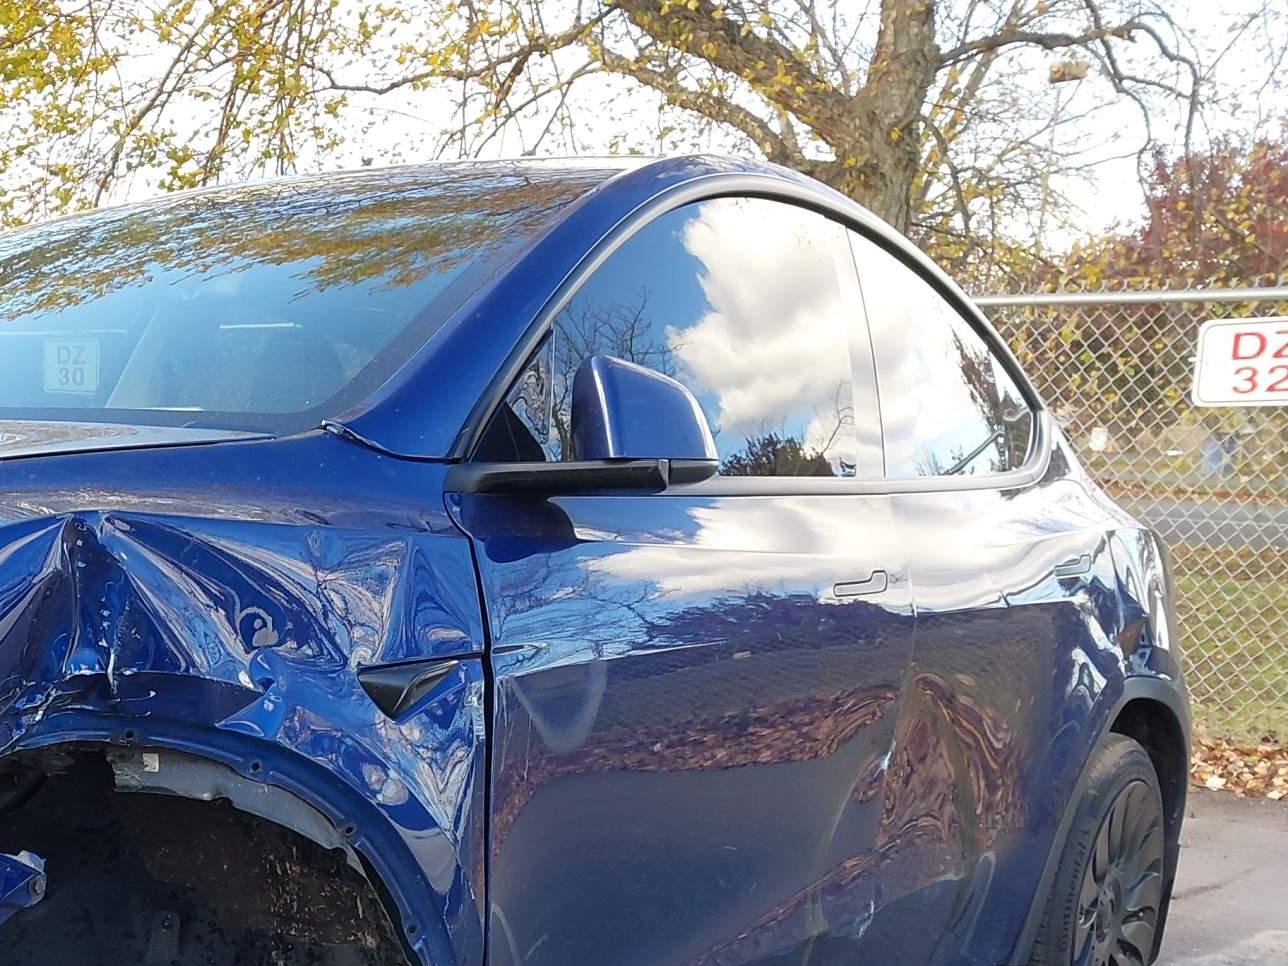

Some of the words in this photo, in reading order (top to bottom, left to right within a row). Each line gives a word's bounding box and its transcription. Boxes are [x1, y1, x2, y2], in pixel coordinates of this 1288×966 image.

[57, 346, 87, 365] DZ
[59, 367, 84, 386] 30
[1232, 365, 1288, 393] 32
